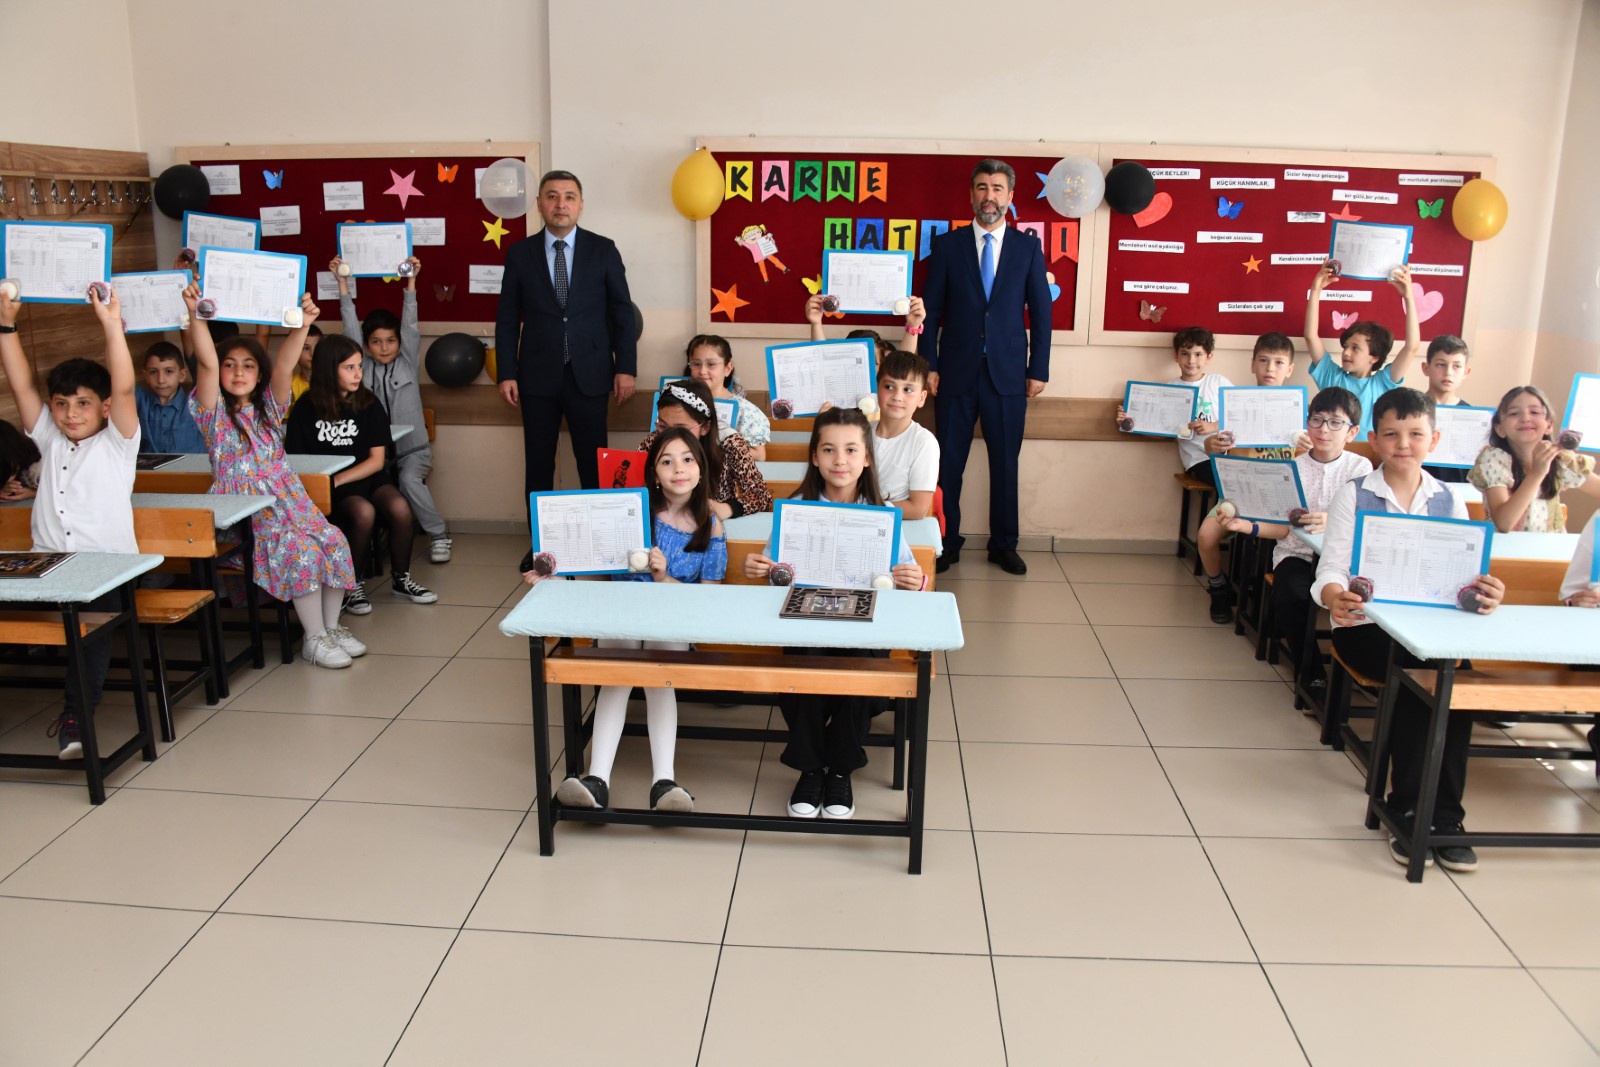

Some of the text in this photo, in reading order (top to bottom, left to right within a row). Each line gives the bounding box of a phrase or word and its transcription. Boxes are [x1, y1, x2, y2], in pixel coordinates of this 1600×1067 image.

[731, 165, 881, 192] KARNE
[1216, 179, 1236, 187] KÜÇÜK
[315, 419, 359, 442] Rock
